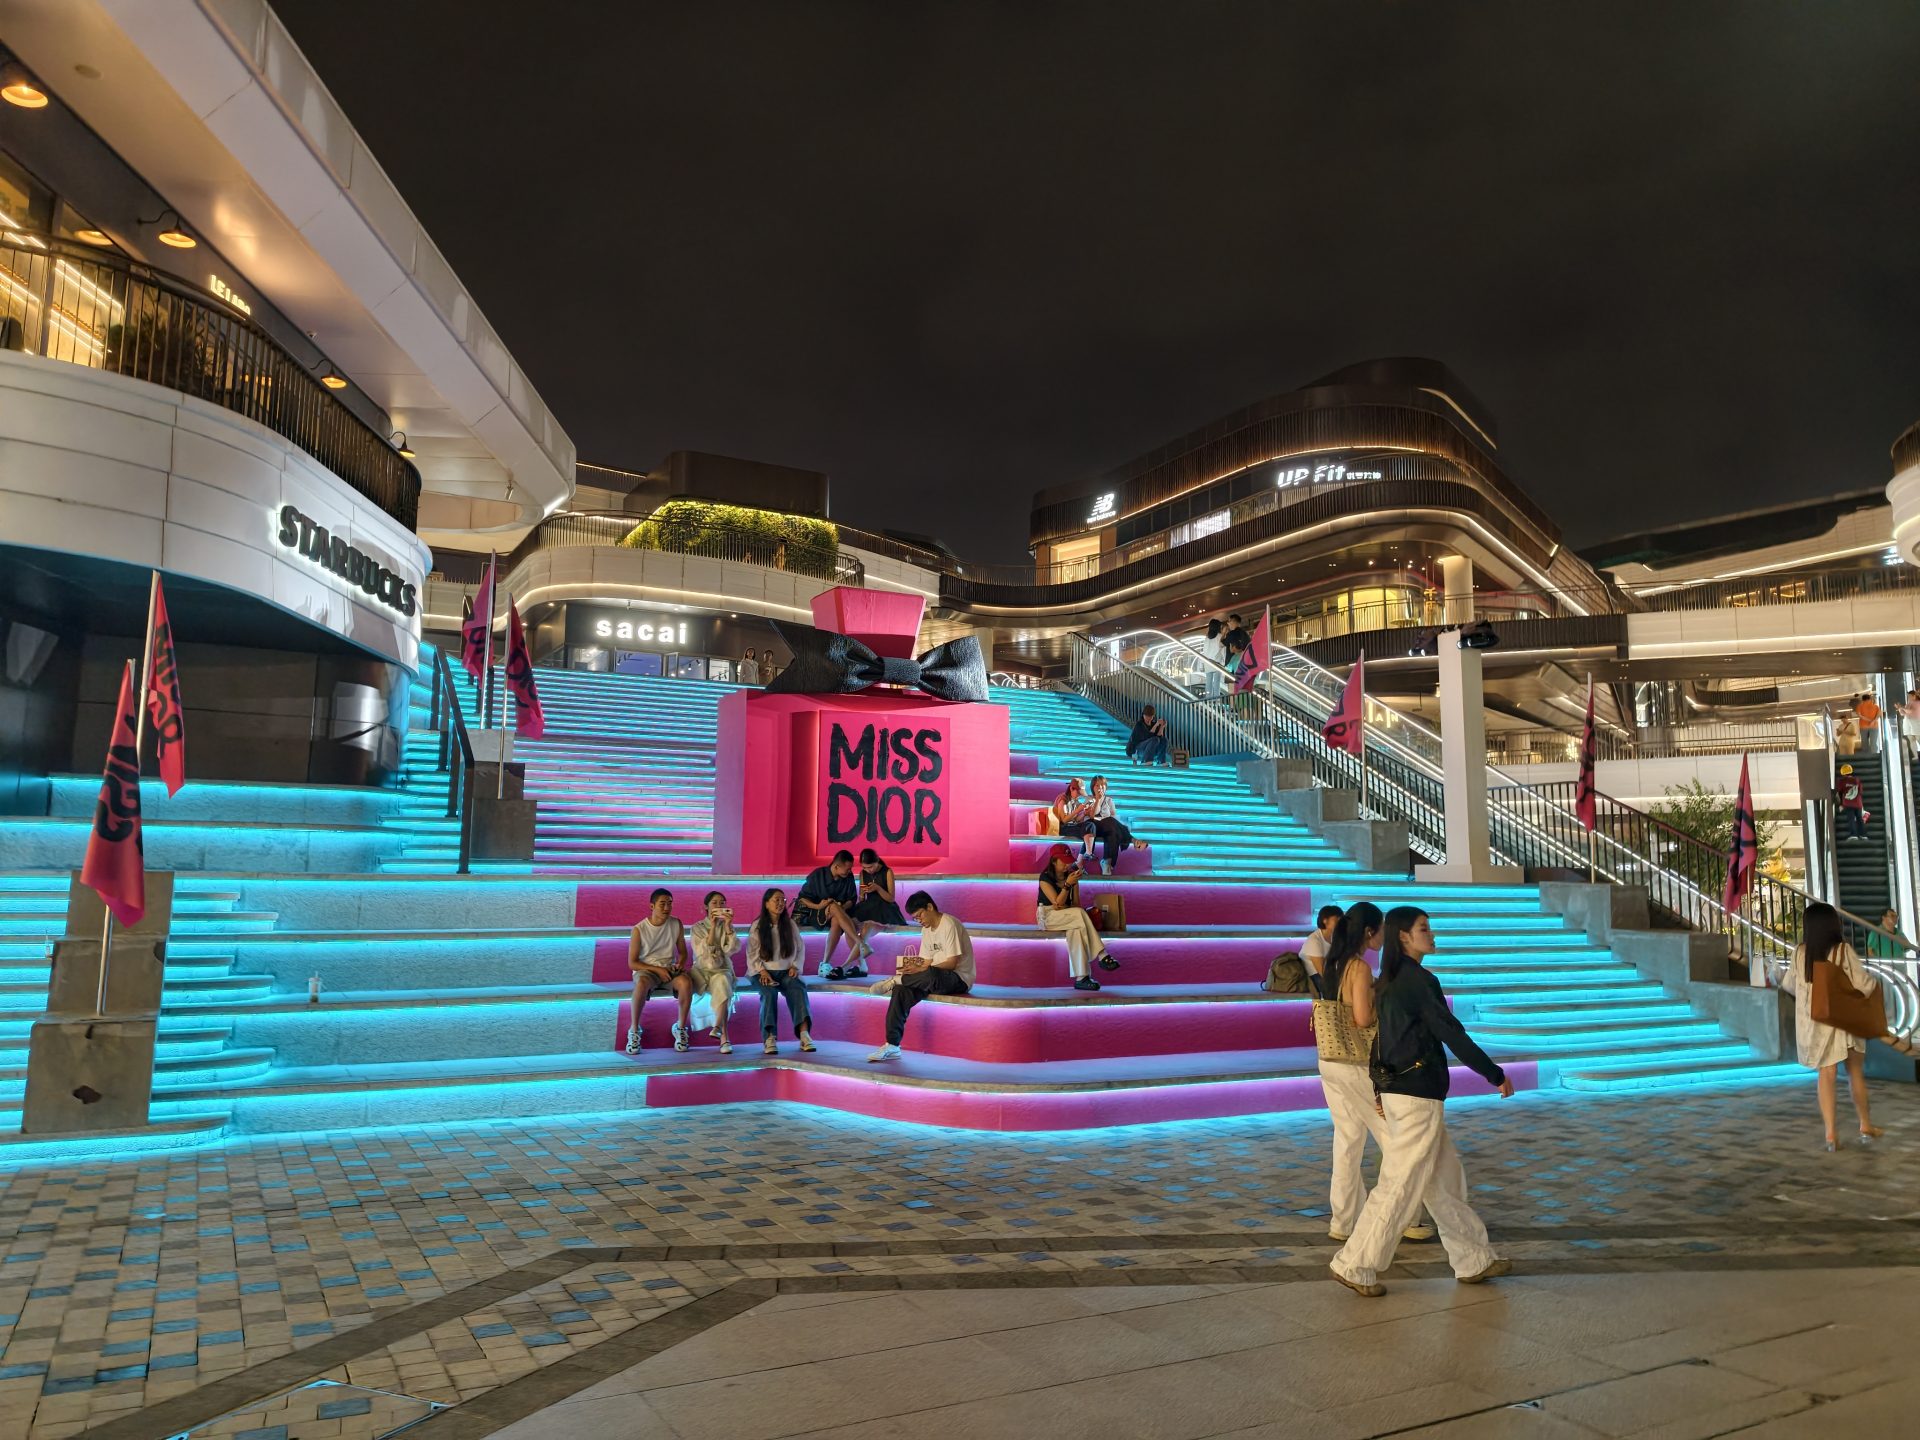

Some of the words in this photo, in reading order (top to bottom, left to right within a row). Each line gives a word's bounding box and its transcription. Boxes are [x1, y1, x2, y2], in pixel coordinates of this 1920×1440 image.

[1277, 468, 1310, 488] UP
[1313, 464, 1346, 483] Fit
[278, 505, 417, 618] STARBUCKS
[595, 620, 688, 645] sacai
[829, 723, 943, 784] MISS
[827, 782, 943, 845] DIOR
